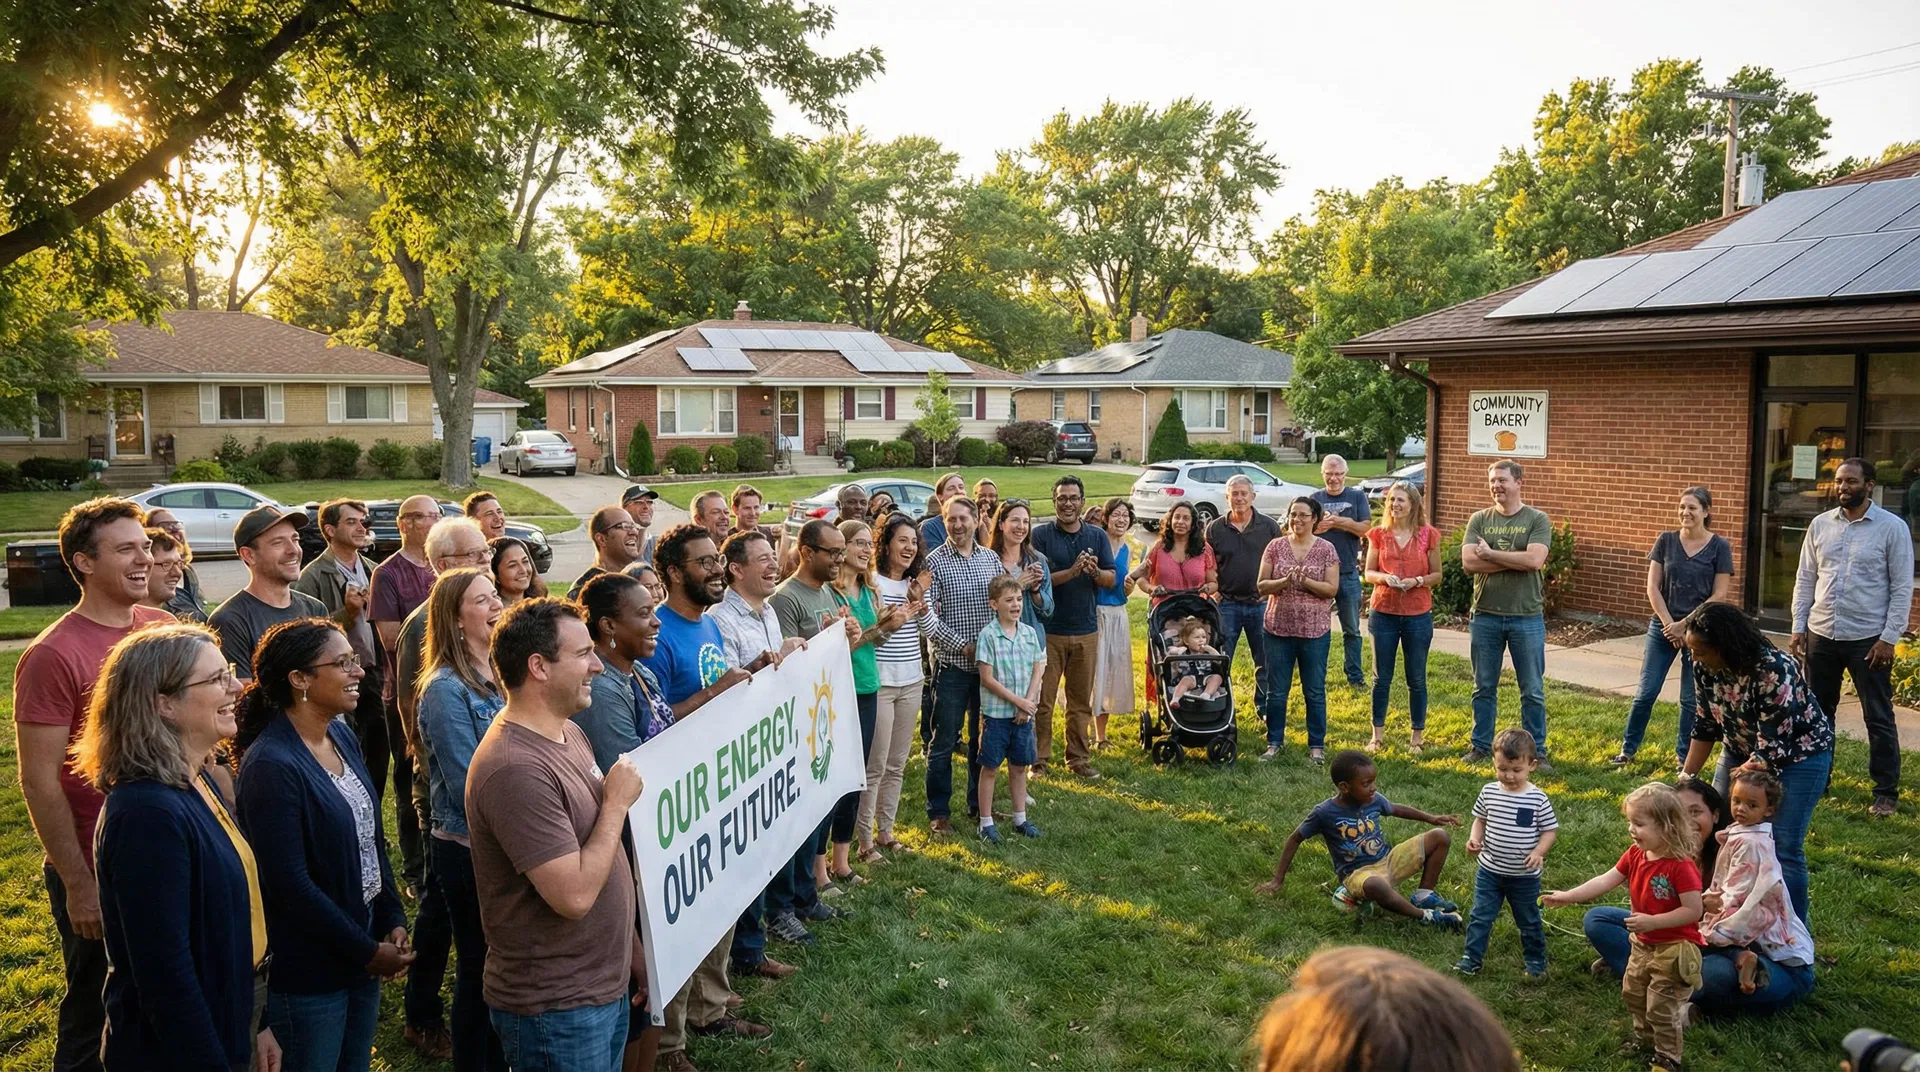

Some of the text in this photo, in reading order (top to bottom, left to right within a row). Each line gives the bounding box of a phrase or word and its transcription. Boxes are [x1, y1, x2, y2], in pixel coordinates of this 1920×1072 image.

[1473, 395, 1543, 412] COMMUNITY
[1484, 413, 1530, 427] BAKERY
[657, 695, 799, 850] OUR ENERGY,
[663, 756, 801, 925] OUR FUTURE.
